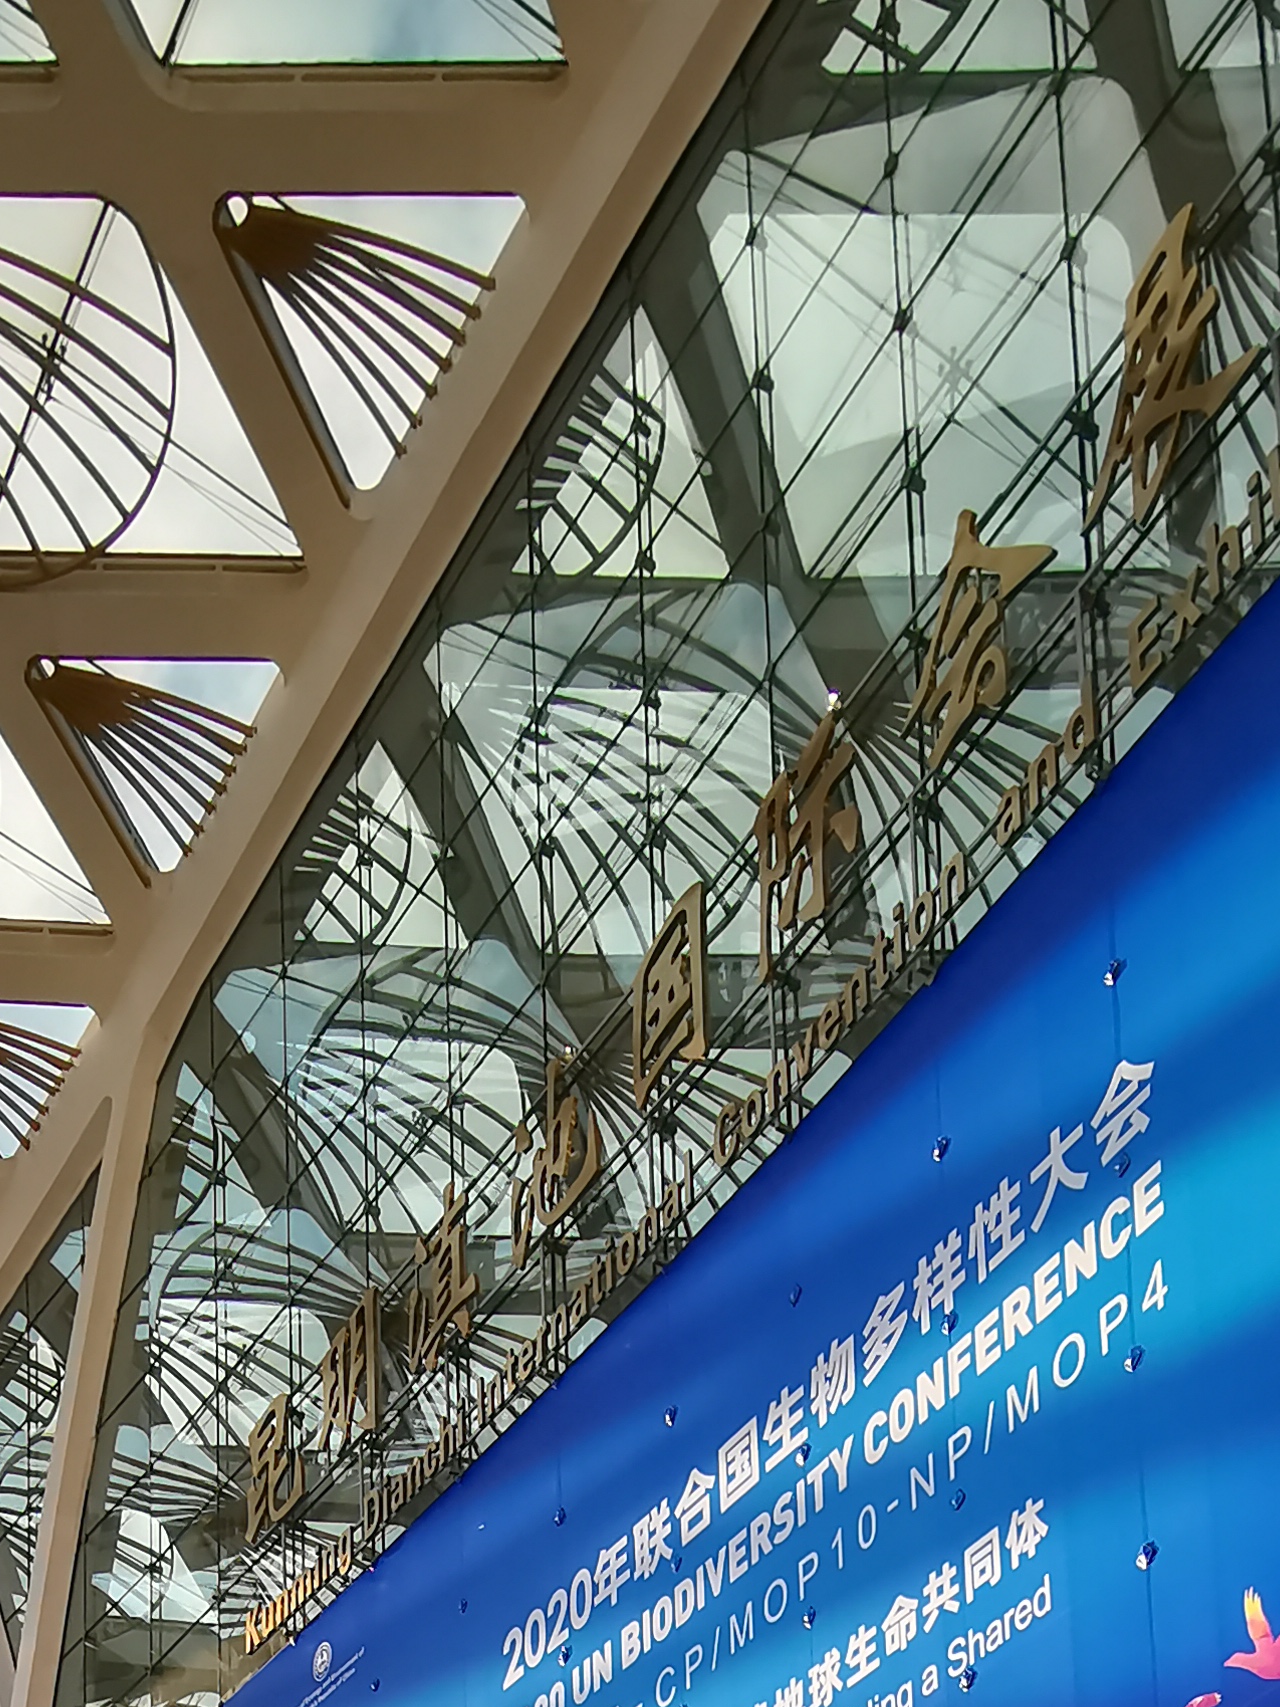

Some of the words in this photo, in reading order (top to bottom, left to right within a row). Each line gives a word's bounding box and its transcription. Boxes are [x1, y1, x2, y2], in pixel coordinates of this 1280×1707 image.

[243, 1528, 353, 1655] Kunming
[363, 1402, 466, 1541] Dianchi
[477, 1148, 695, 1416] International
[714, 852, 968, 1168] Convention
[994, 671, 1100, 847] and
[502, 1059, 1154, 1690] 2020年联合国生物多样性大会
[572, 1639, 613, 1706] UN
[621, 1432, 854, 1670] BIODIVERSITY
[863, 1159, 1164, 1465] CONFERENCE
[921, 1664, 939, 1695] a
[947, 1573, 1052, 1679] Shared
